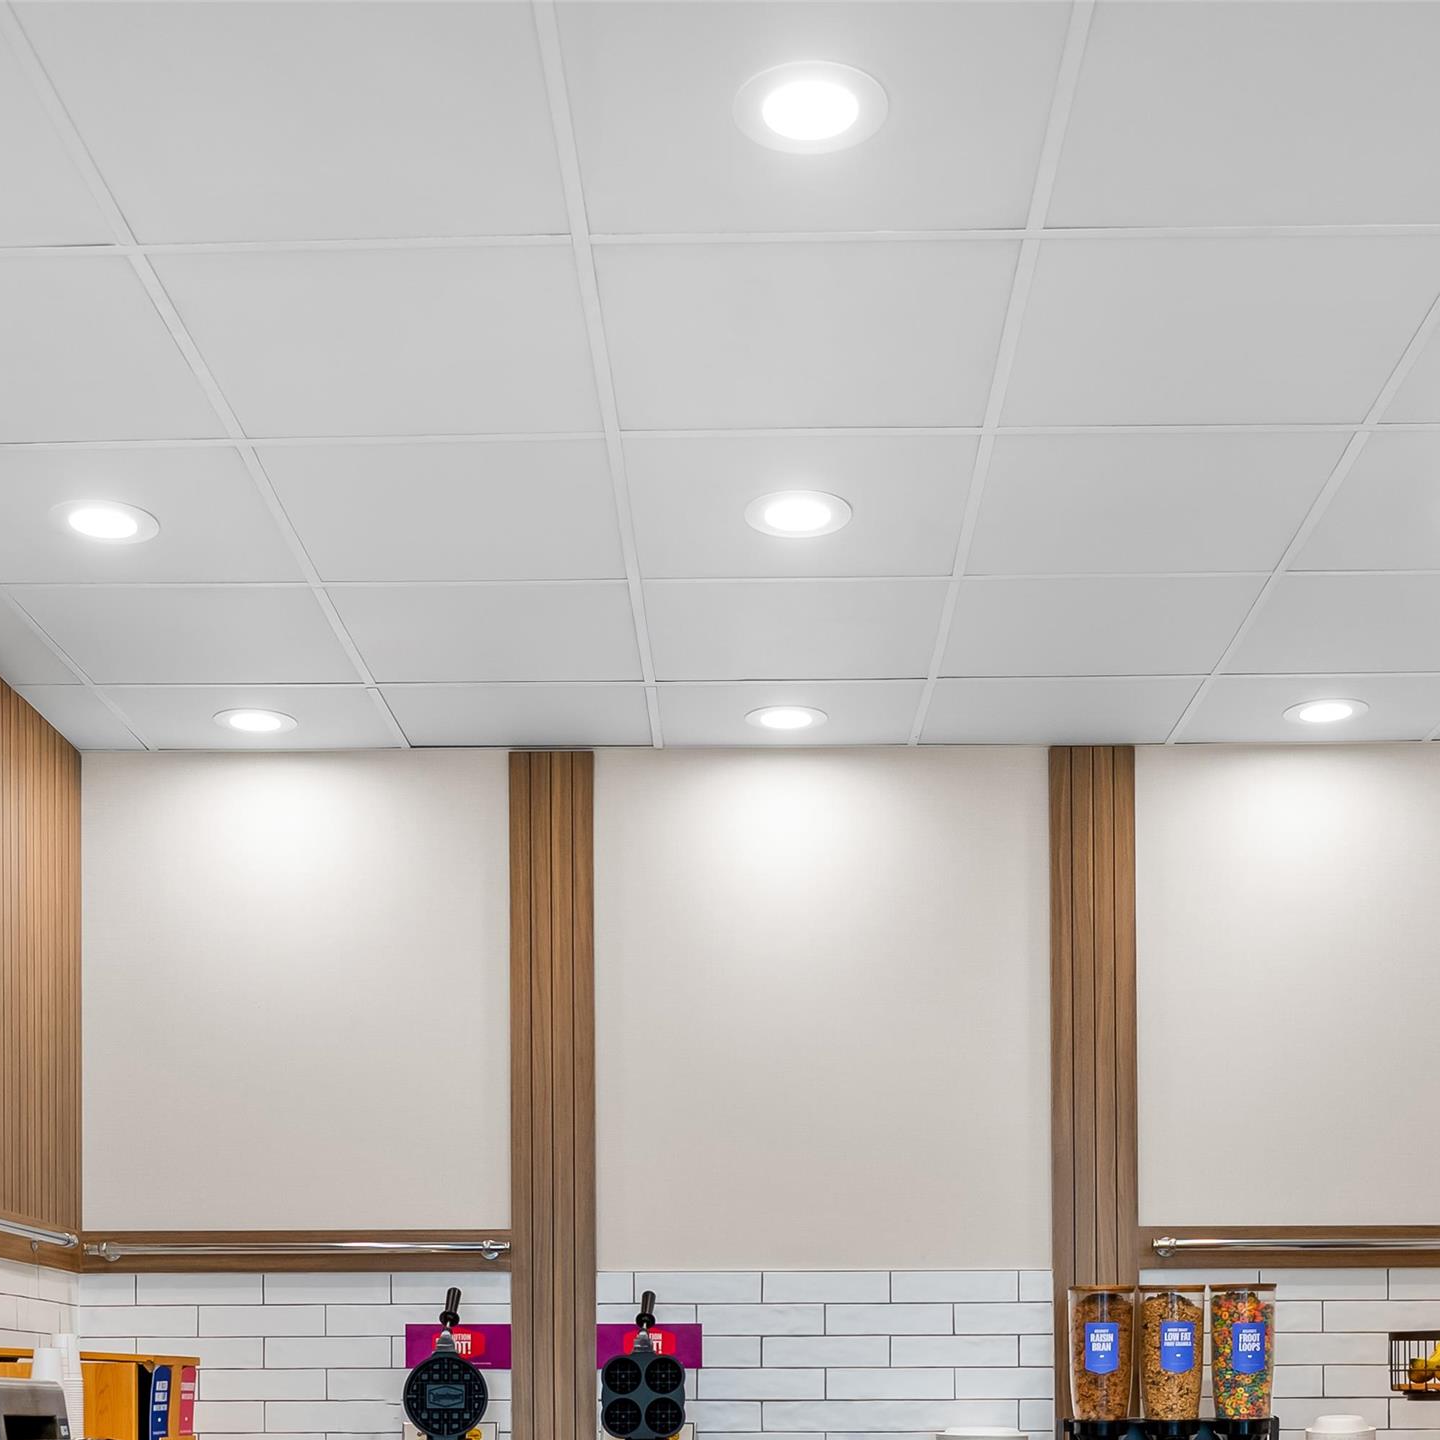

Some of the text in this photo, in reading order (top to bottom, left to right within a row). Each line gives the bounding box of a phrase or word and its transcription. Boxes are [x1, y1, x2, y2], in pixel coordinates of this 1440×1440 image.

[1090, 1333, 1114, 1343] RAISIN
[1164, 1332, 1192, 1342] LOW FAT
[1238, 1333, 1261, 1343] FROOT
[1091, 1342, 1112, 1352] BRAN
[1238, 1342, 1261, 1352] LOOPS
